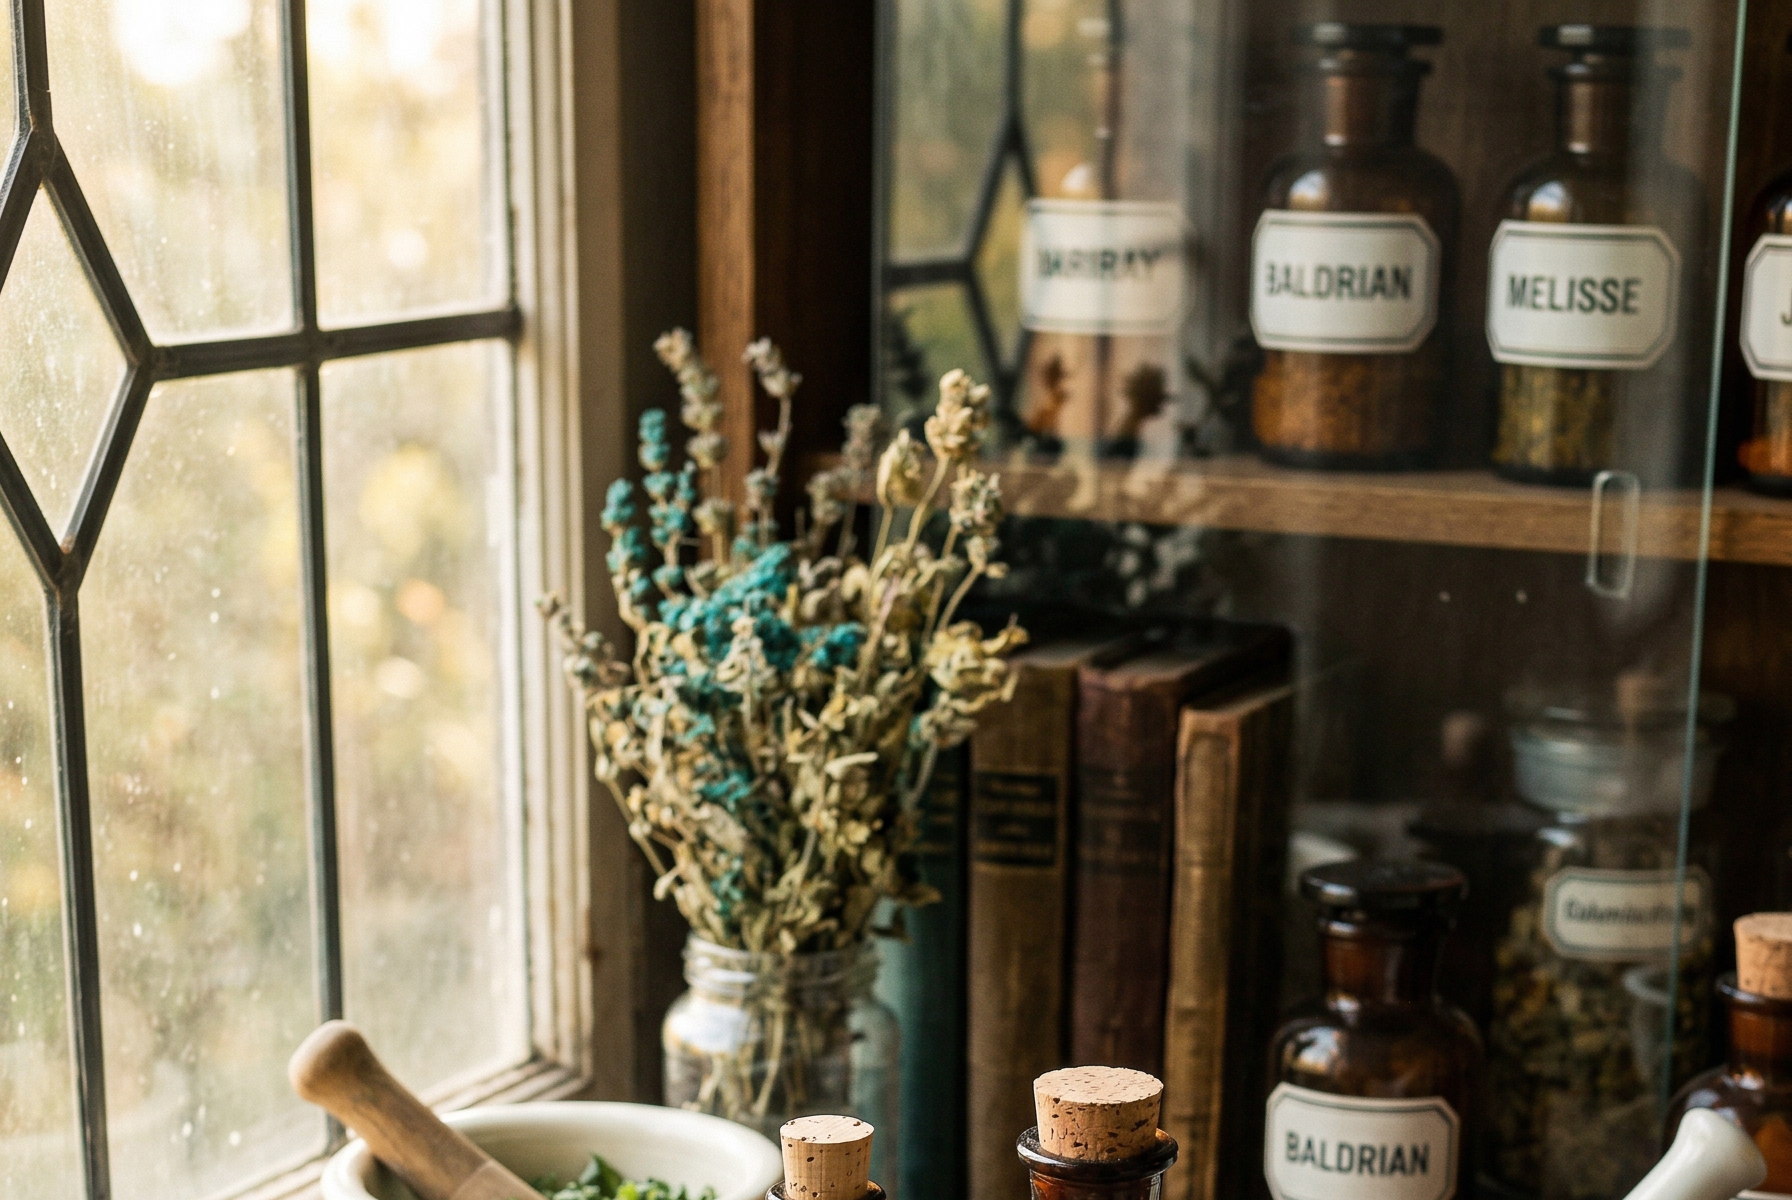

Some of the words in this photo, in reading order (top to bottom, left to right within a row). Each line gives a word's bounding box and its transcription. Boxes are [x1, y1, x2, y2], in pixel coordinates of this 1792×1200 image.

[1266, 262, 1412, 299] BALDRIAN
[1508, 274, 1642, 315] MELISSE
[1286, 1130, 1429, 1175] BALDRIAN
